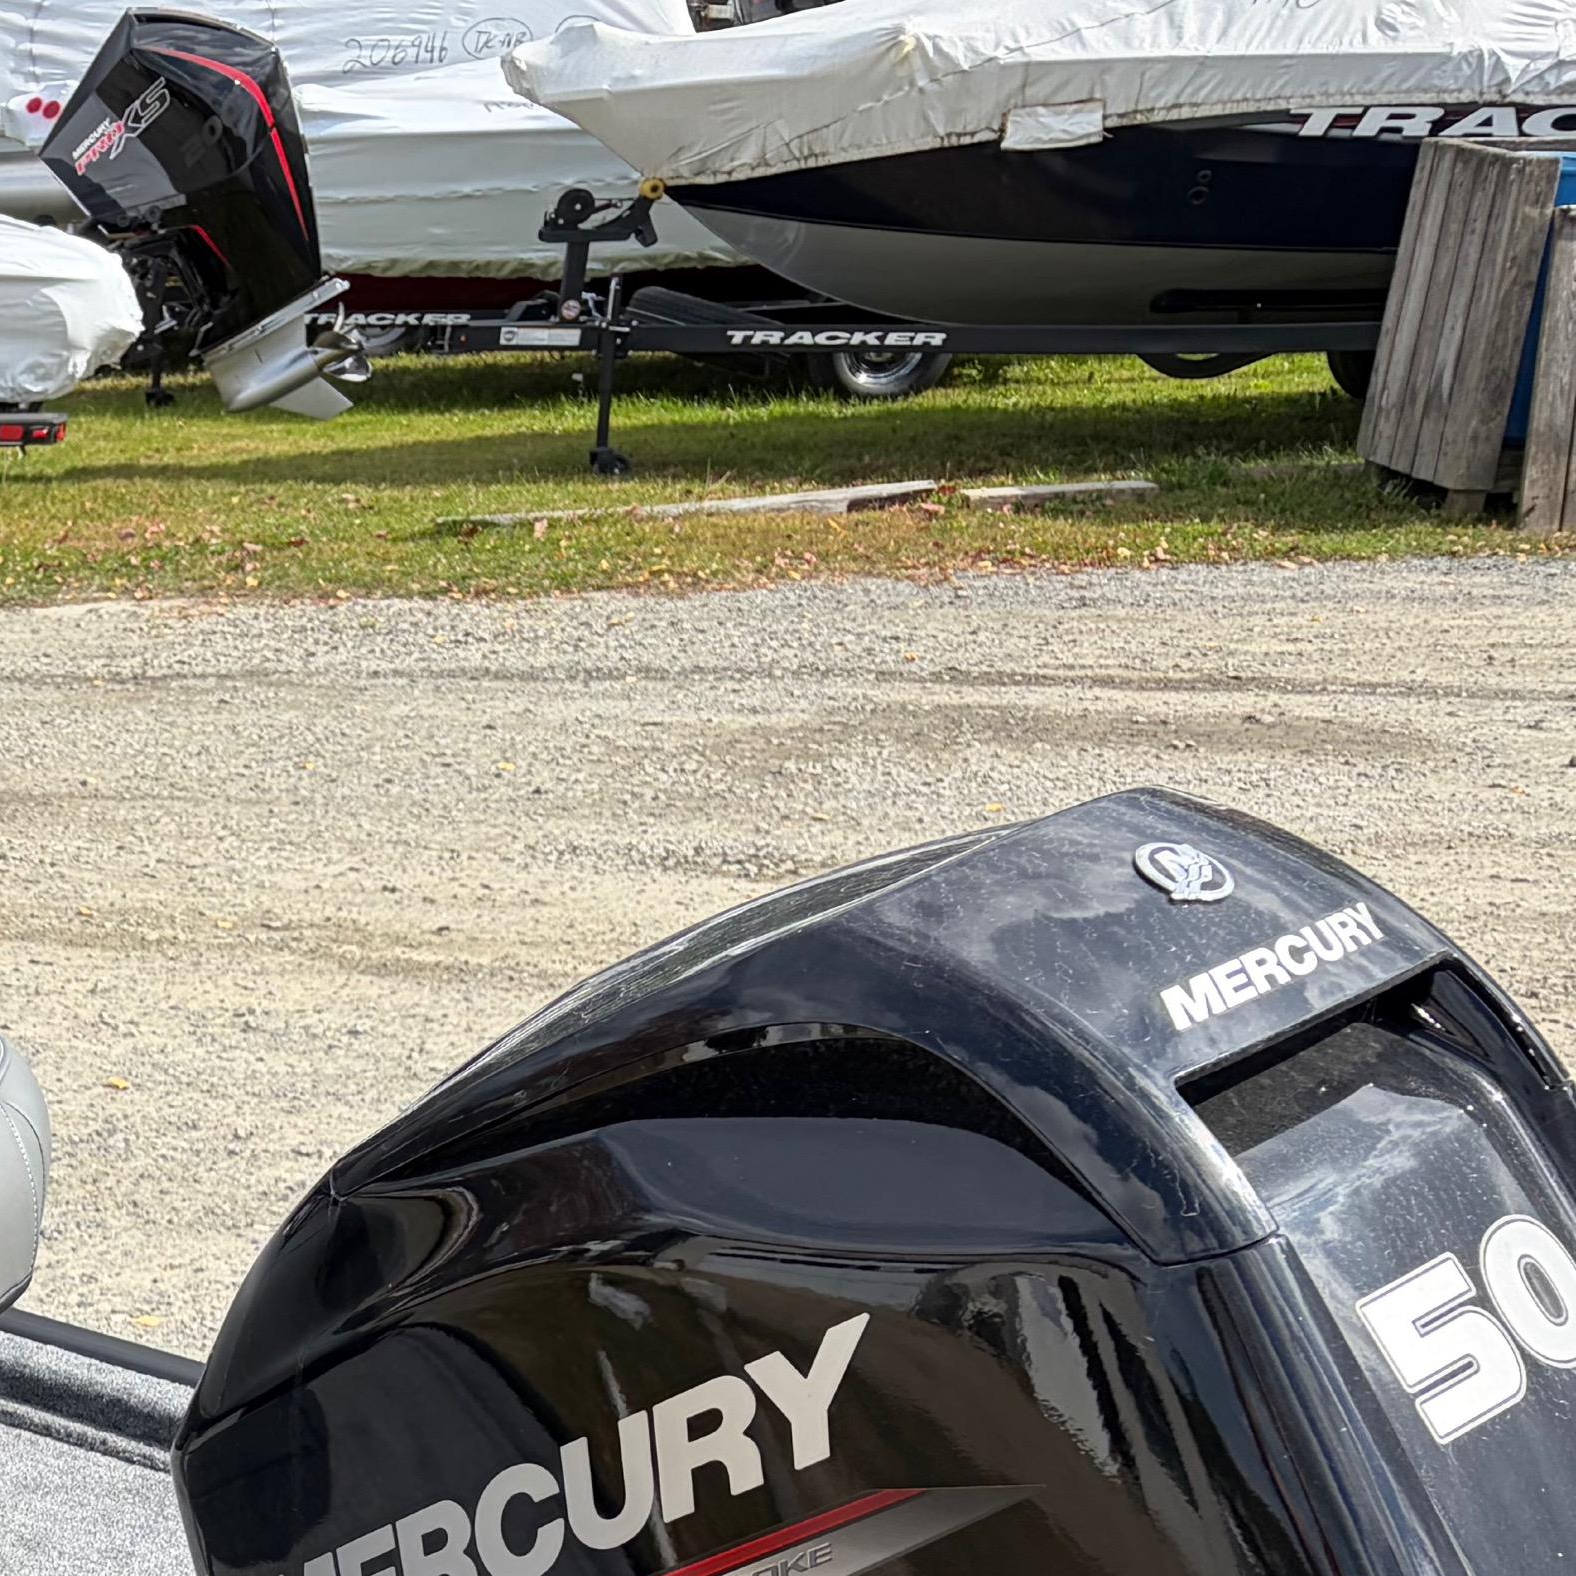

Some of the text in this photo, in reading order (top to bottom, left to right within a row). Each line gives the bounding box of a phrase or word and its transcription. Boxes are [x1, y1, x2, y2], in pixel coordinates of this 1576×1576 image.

[727, 330, 948, 346] TRACKER
[1159, 902, 1384, 1031] MERCURY
[1355, 1213, 1576, 1445] 50
